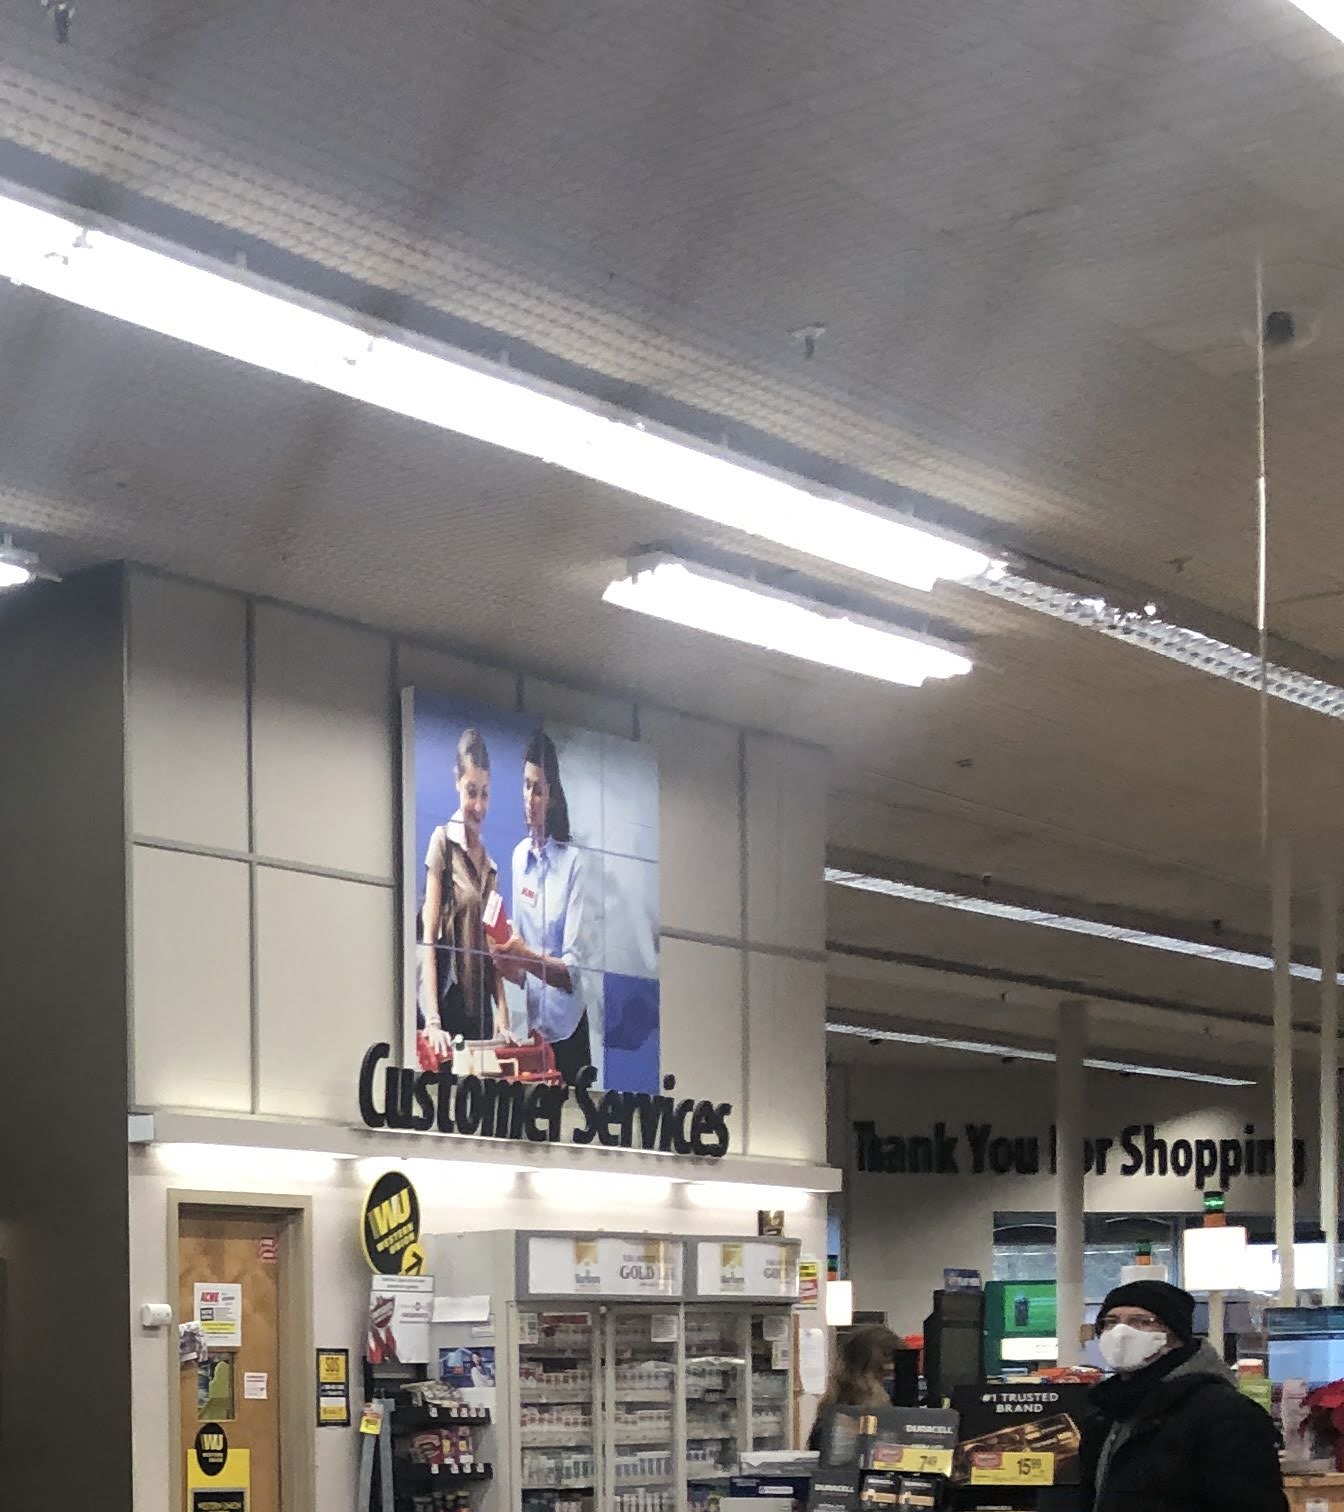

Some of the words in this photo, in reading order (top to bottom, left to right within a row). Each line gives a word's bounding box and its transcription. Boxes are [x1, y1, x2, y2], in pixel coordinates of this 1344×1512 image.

[359, 1042, 568, 1142] Customer
[574, 1065, 732, 1157] Services
[853, 1121, 959, 1176] Thank
[965, 1122, 1039, 1176] You
[1050, 1124, 1112, 1176] or
[368, 1187, 411, 1239] WU
[376, 1221, 414, 1252] WESTERN
[619, 1264, 655, 1281] GOLD
[982, 1393, 998, 1402] #1
[1000, 1392, 1059, 1402] TRUSTED
[995, 1404, 1044, 1413] BRAND
[905, 1424, 954, 1434] DURACELL
[814, 1484, 855, 1493] DURACELL
